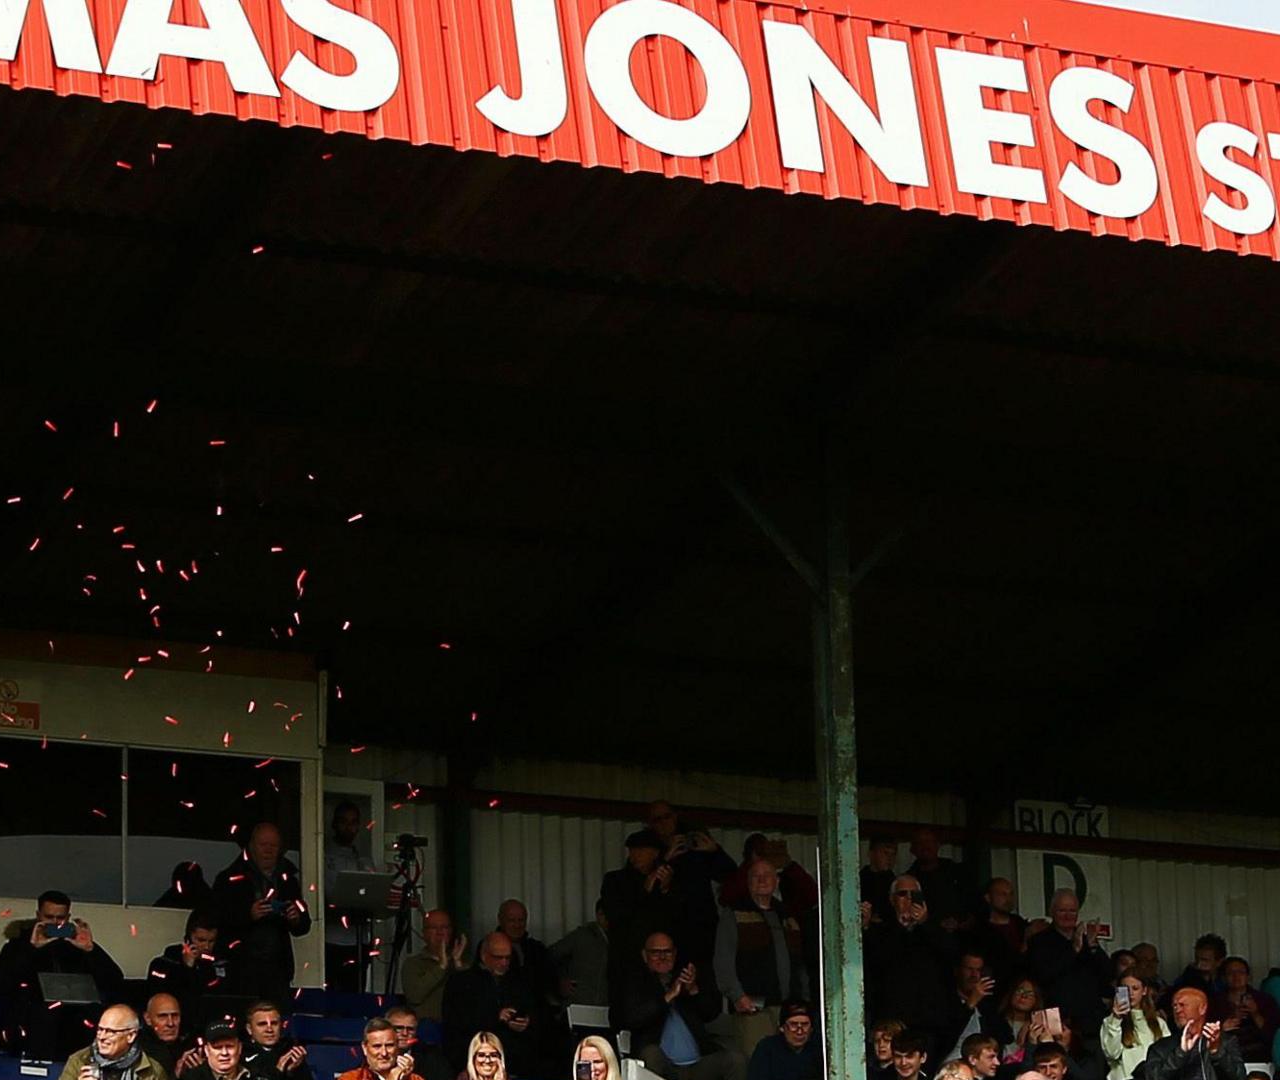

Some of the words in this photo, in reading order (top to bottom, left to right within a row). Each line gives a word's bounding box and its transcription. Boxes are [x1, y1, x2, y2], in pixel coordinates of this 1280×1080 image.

[475, 0, 1159, 219] JONES
[0, 702, 18, 714] No
[1018, 803, 1104, 838] BLOCK
